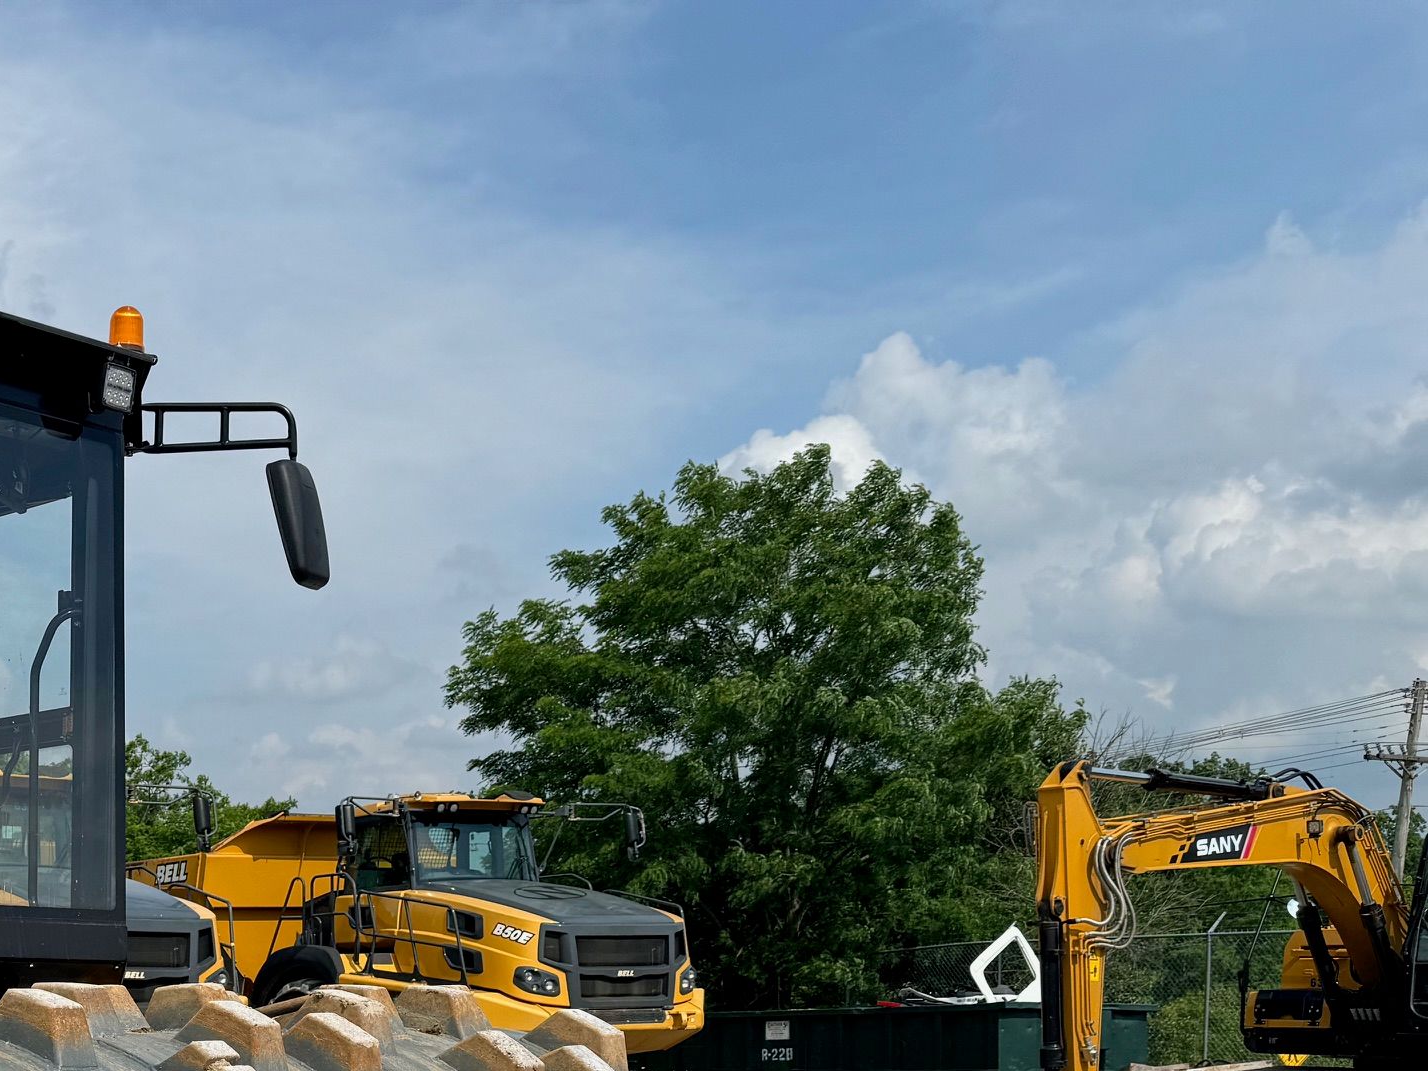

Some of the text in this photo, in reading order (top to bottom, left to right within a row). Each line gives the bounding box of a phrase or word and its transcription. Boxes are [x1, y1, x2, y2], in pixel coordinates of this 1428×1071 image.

[1196, 833, 1243, 857] SANY
[155, 861, 188, 885] BELL
[491, 922, 535, 945] B50E
[124, 970, 146, 979] BELL
[617, 969, 635, 977] BELL
